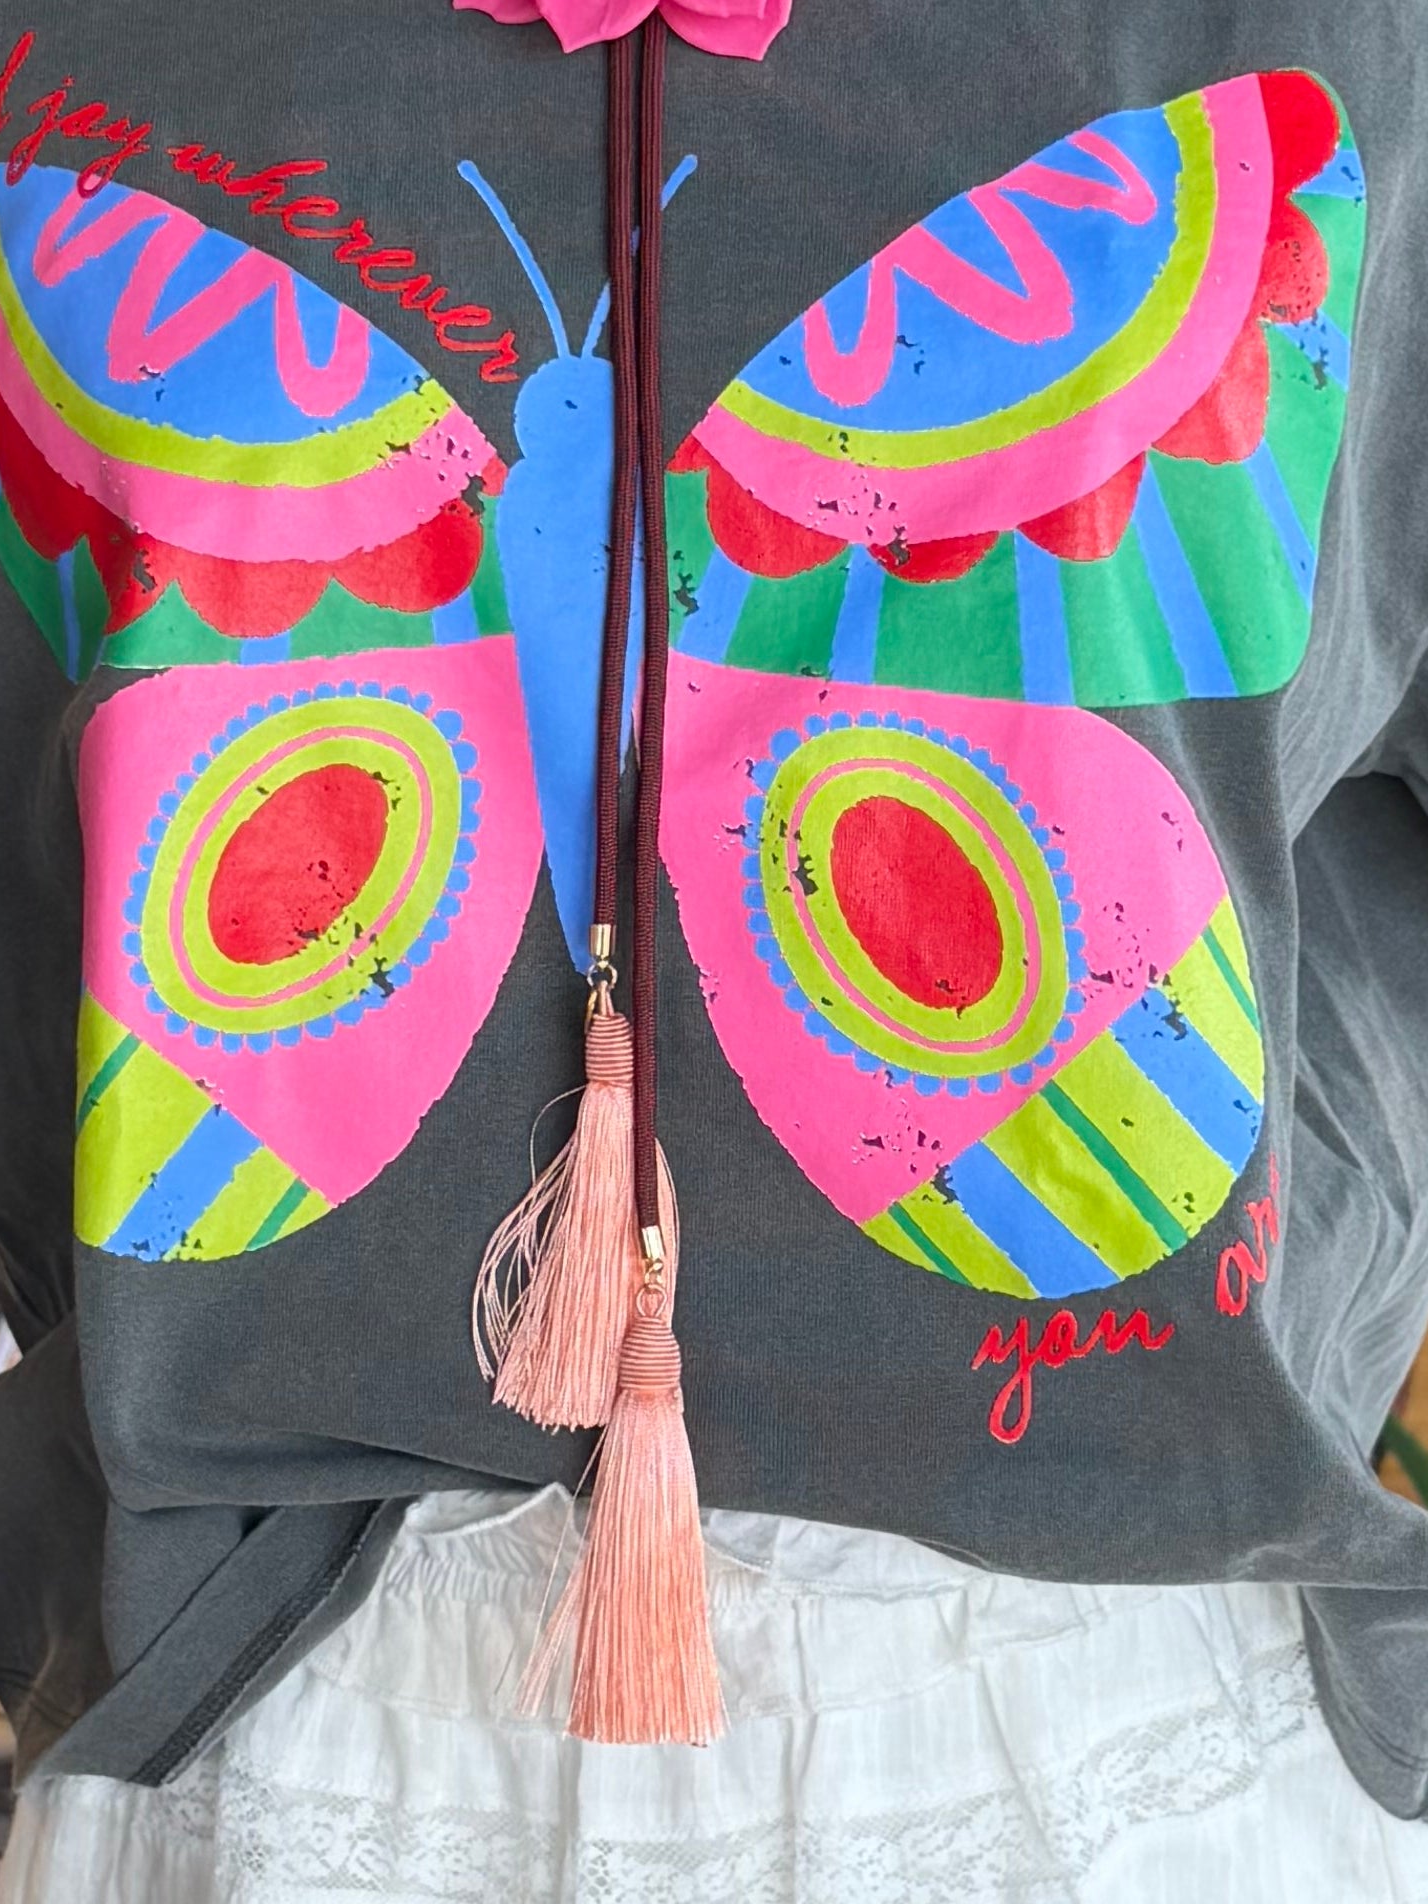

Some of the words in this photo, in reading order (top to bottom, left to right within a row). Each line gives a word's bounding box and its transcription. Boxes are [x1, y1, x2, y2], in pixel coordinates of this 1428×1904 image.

[5, 74, 154, 198] joy
[166, 142, 520, 384] wherever
[972, 1308, 1175, 1445] you
